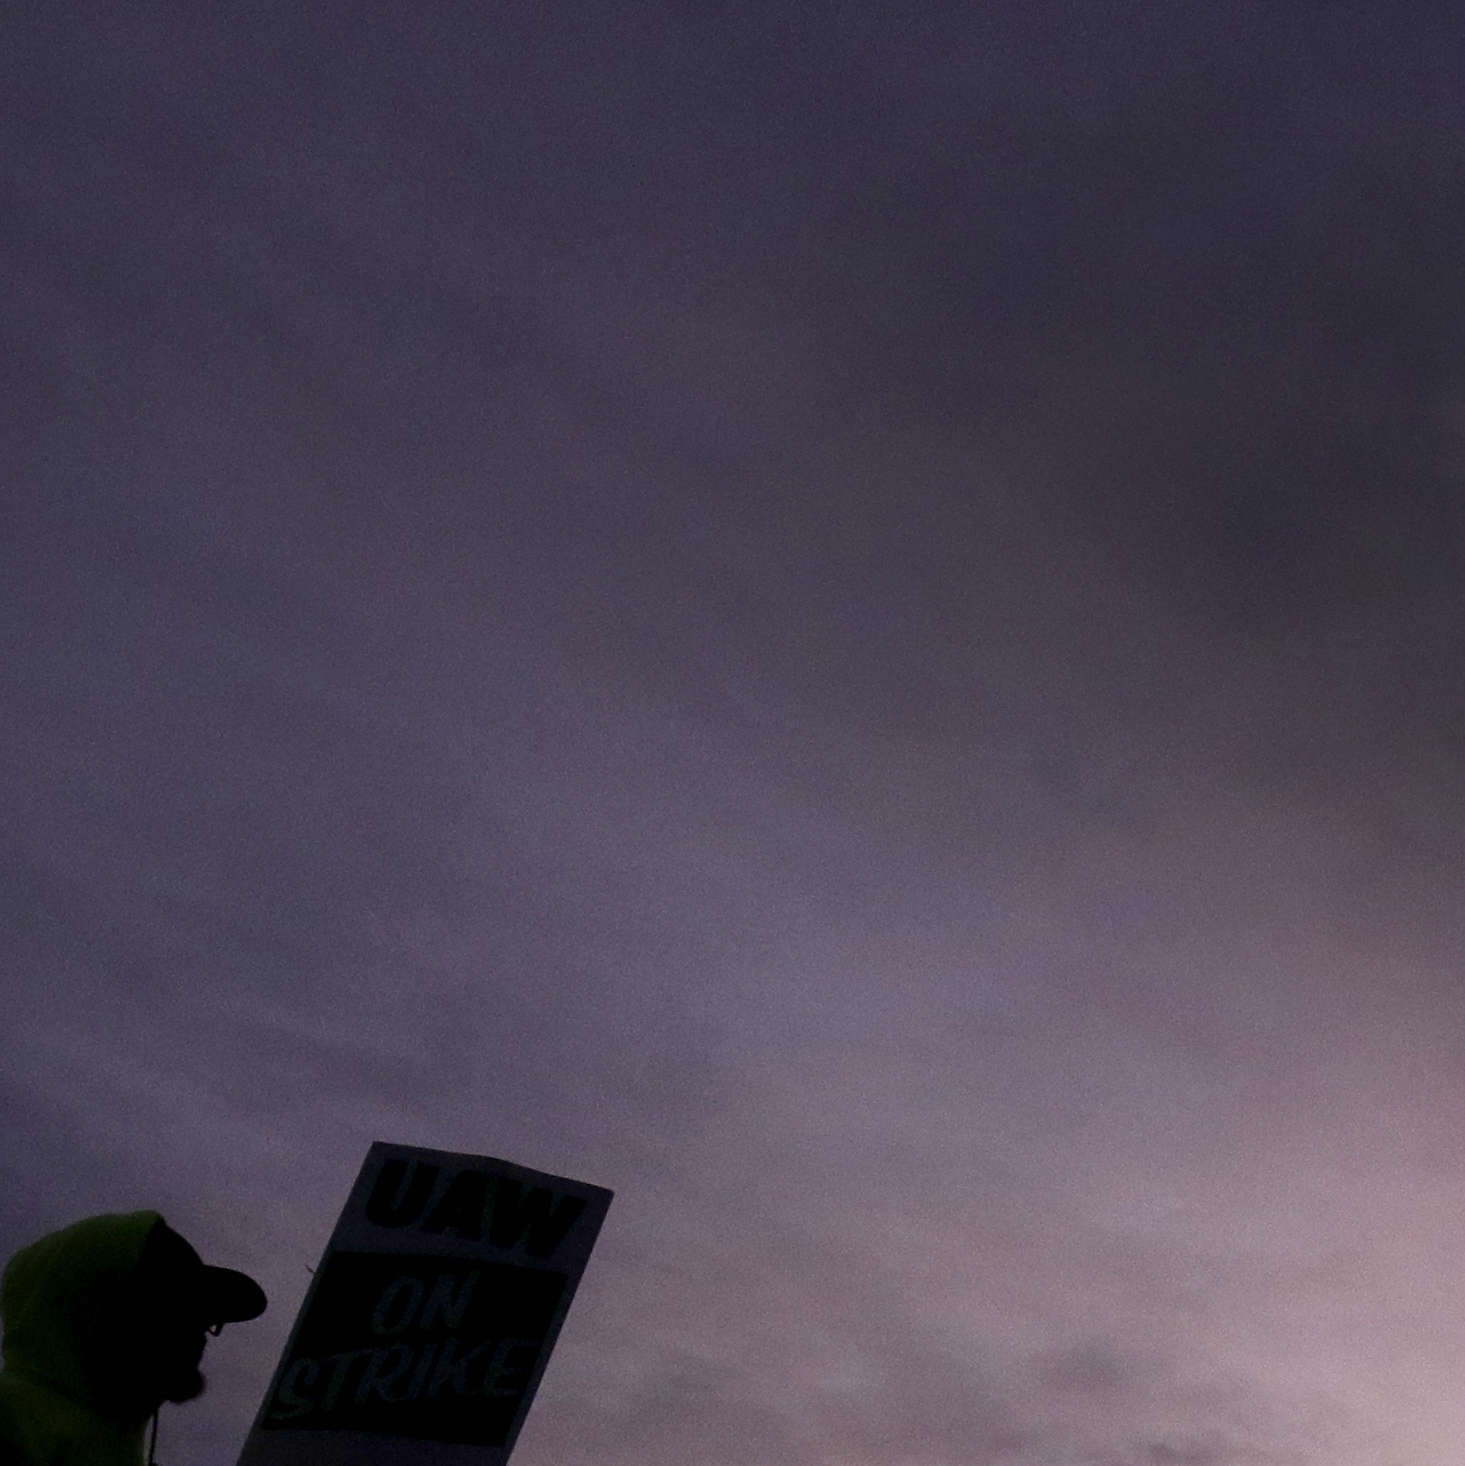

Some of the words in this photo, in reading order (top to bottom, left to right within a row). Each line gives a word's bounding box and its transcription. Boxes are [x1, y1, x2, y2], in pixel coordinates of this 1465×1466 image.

[366, 1159, 586, 1258] UAW
[370, 1268, 483, 1336] ON
[269, 1336, 542, 1420] STRIKE
